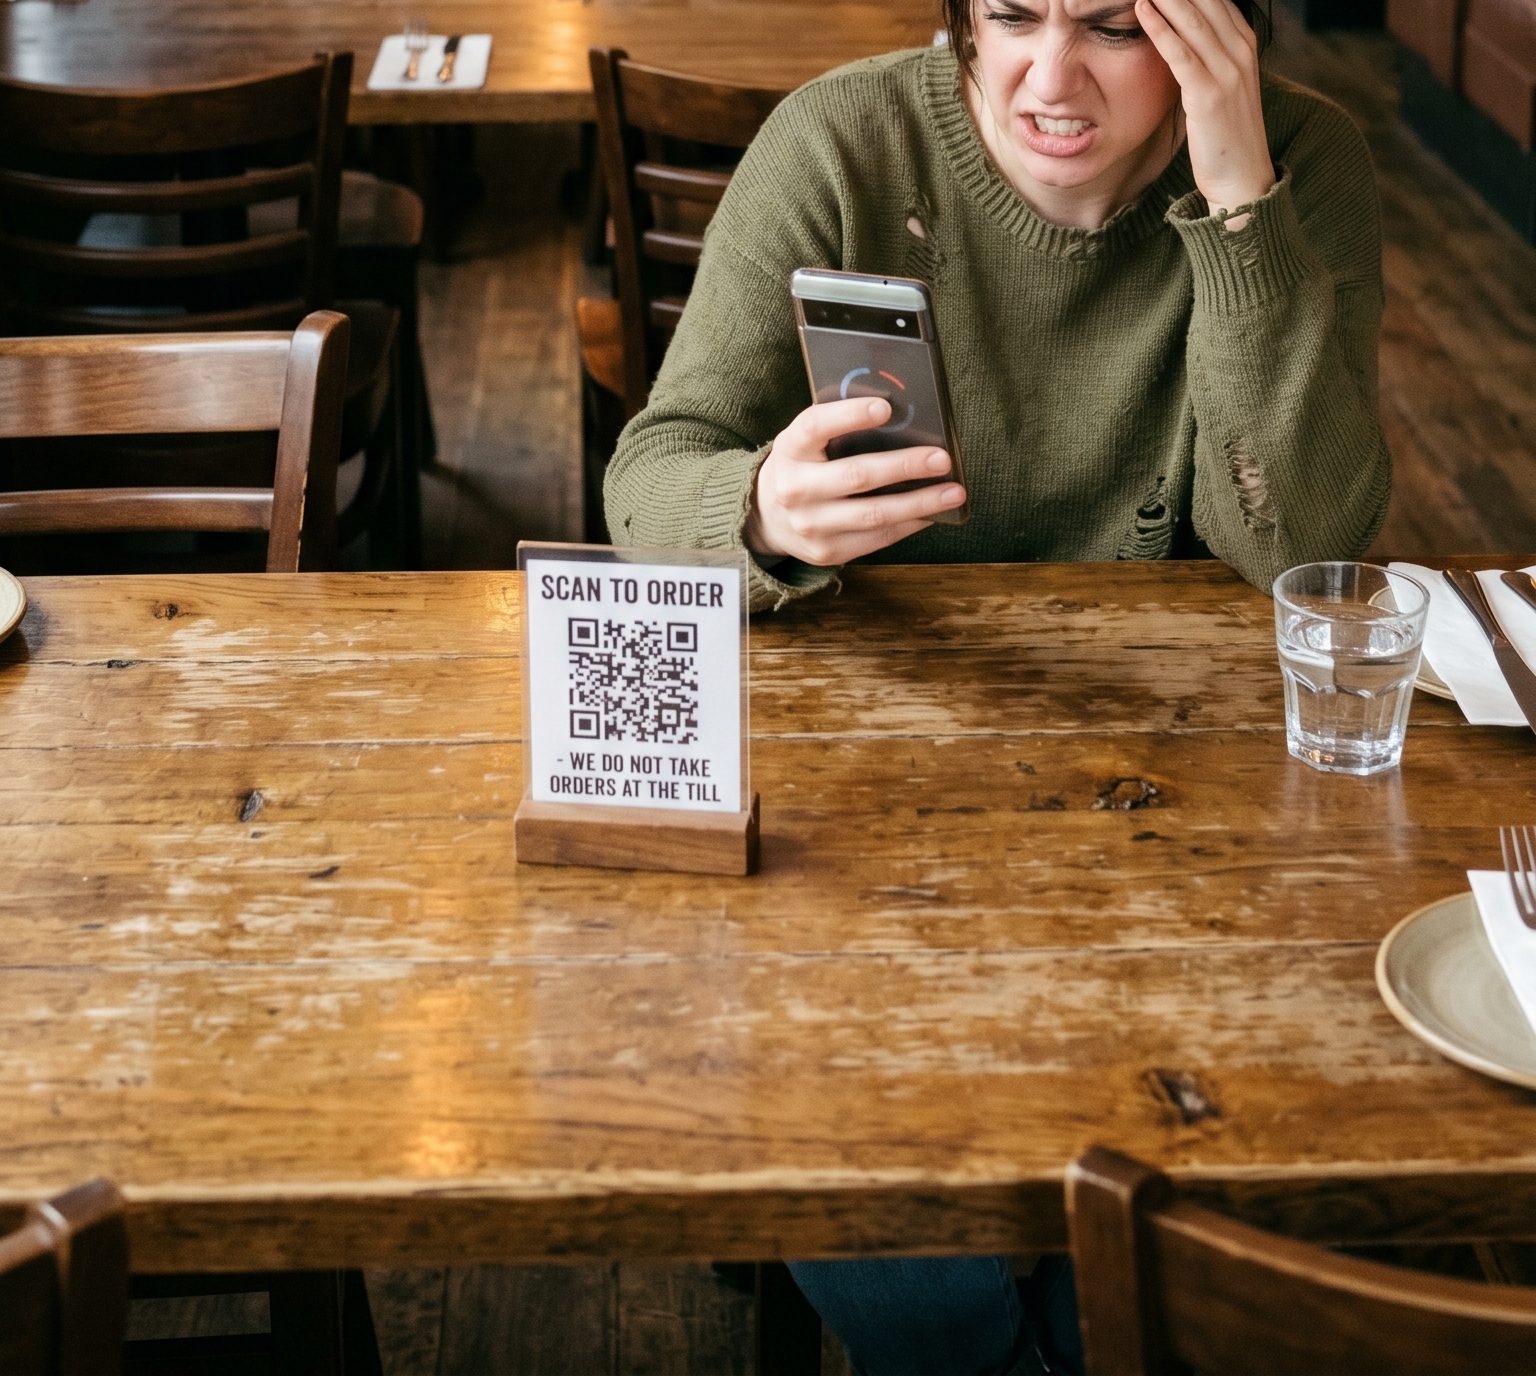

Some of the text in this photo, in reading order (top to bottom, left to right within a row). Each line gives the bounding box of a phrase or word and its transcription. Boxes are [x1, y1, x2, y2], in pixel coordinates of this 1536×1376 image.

[541, 574, 724, 608] SCAN TO ORDER
[570, 752, 596, 771] WE
[602, 753, 624, 773] DO
[630, 755, 663, 775] NOT
[669, 757, 711, 778] TAKE
[550, 775, 721, 802] ORDERS AT THE TILL
